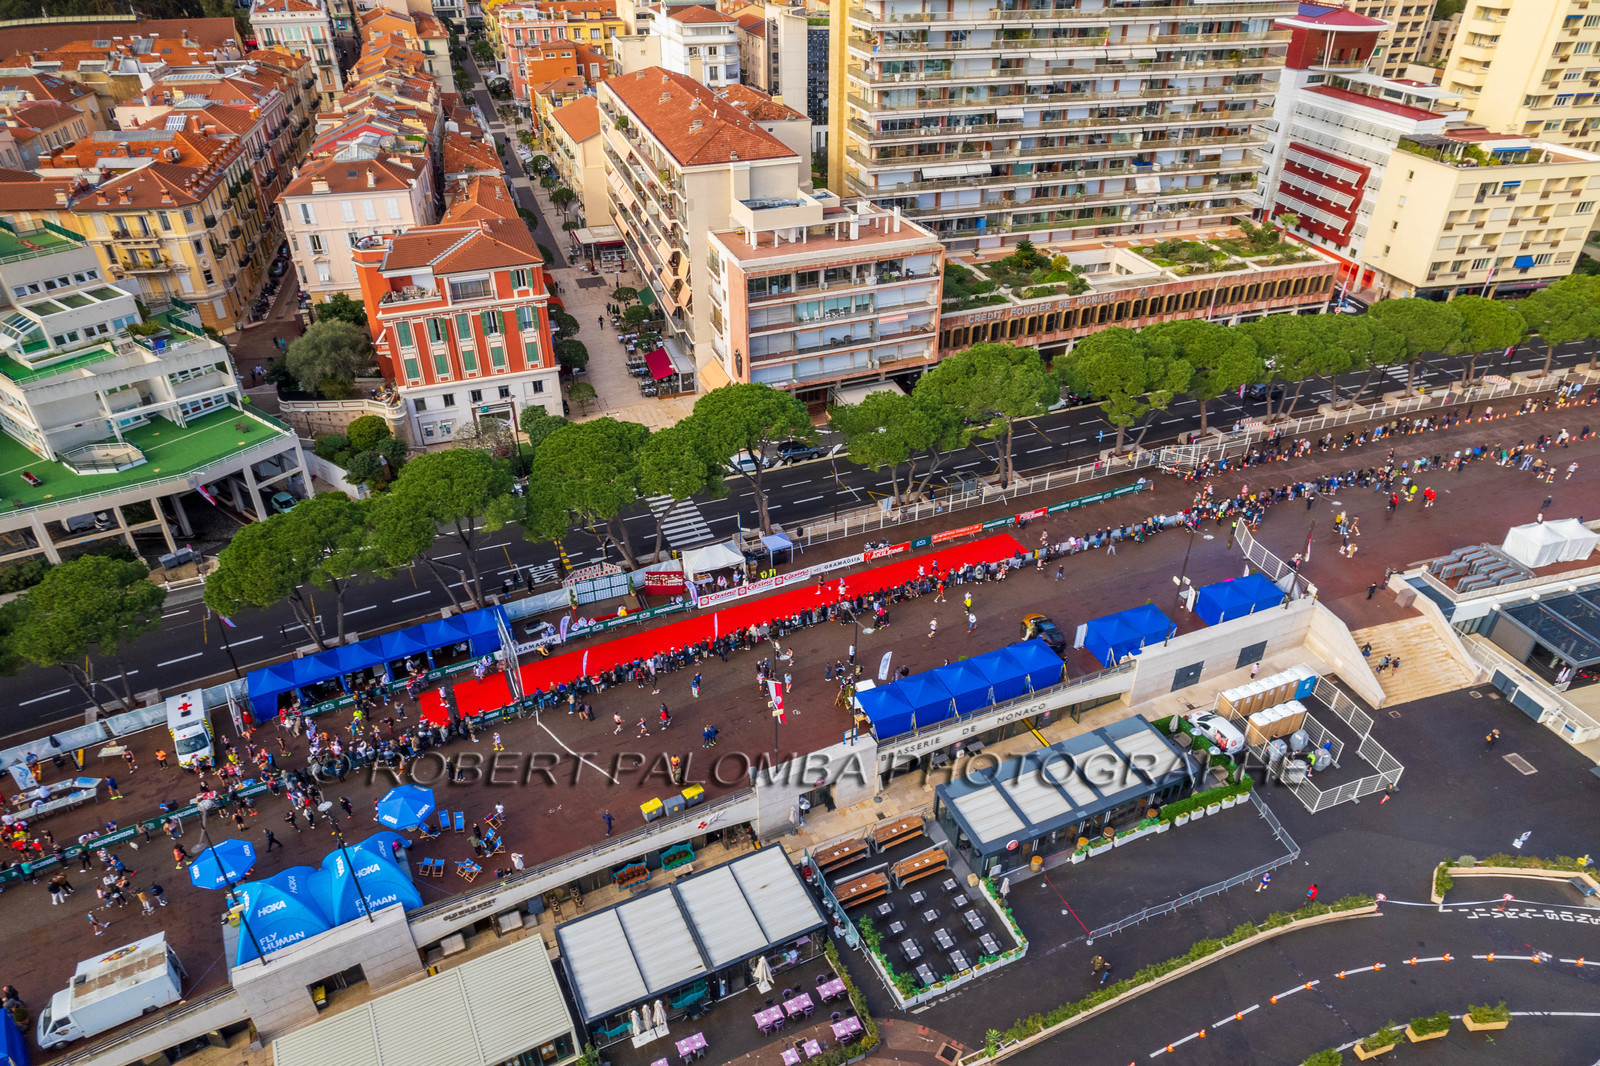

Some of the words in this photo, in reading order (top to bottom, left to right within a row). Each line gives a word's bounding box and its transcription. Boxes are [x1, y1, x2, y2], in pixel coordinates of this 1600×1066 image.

[1010, 303, 1051, 316] FONCIER
[1058, 300, 1071, 309] DE
[1077, 292, 1116, 306] MONACO
[824, 557, 861, 570] GRAMAGLIA
[784, 569, 809, 581] Casino
[747, 579, 773, 591] Casino
[709, 589, 737, 601] Casino
[880, 736, 941, 761] BRASSERIE
[962, 725, 977, 736] DE
[997, 702, 1047, 724] MONACO
[382, 814, 398, 825] HOKA
[355, 863, 381, 878] HOKA
[257, 900, 287, 918] HOKA
[260, 932, 278, 946] FLY
[262, 931, 306, 953] HUMAN
